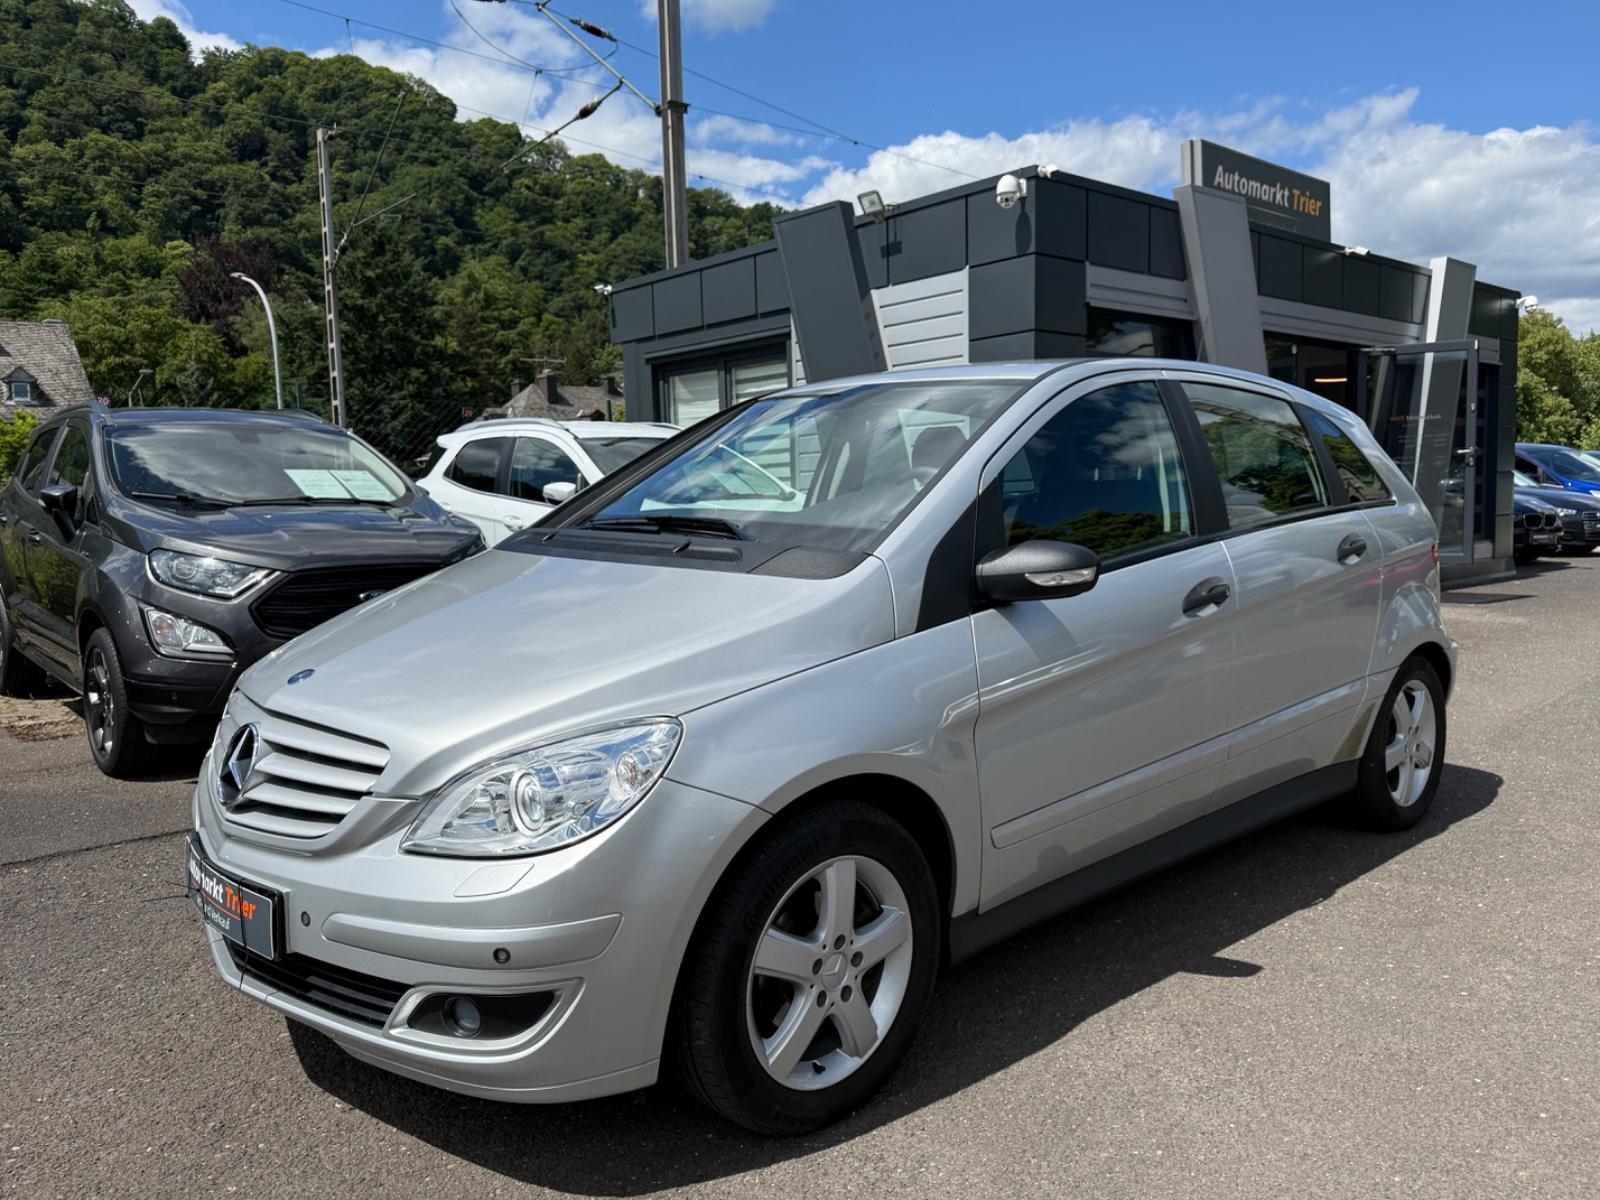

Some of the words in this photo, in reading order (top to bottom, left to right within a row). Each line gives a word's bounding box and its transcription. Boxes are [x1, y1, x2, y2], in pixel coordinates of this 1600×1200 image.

[1213, 165, 1290, 208] Automarkt
[1292, 189, 1322, 217] Trier
[224, 886, 256, 919] Trier
